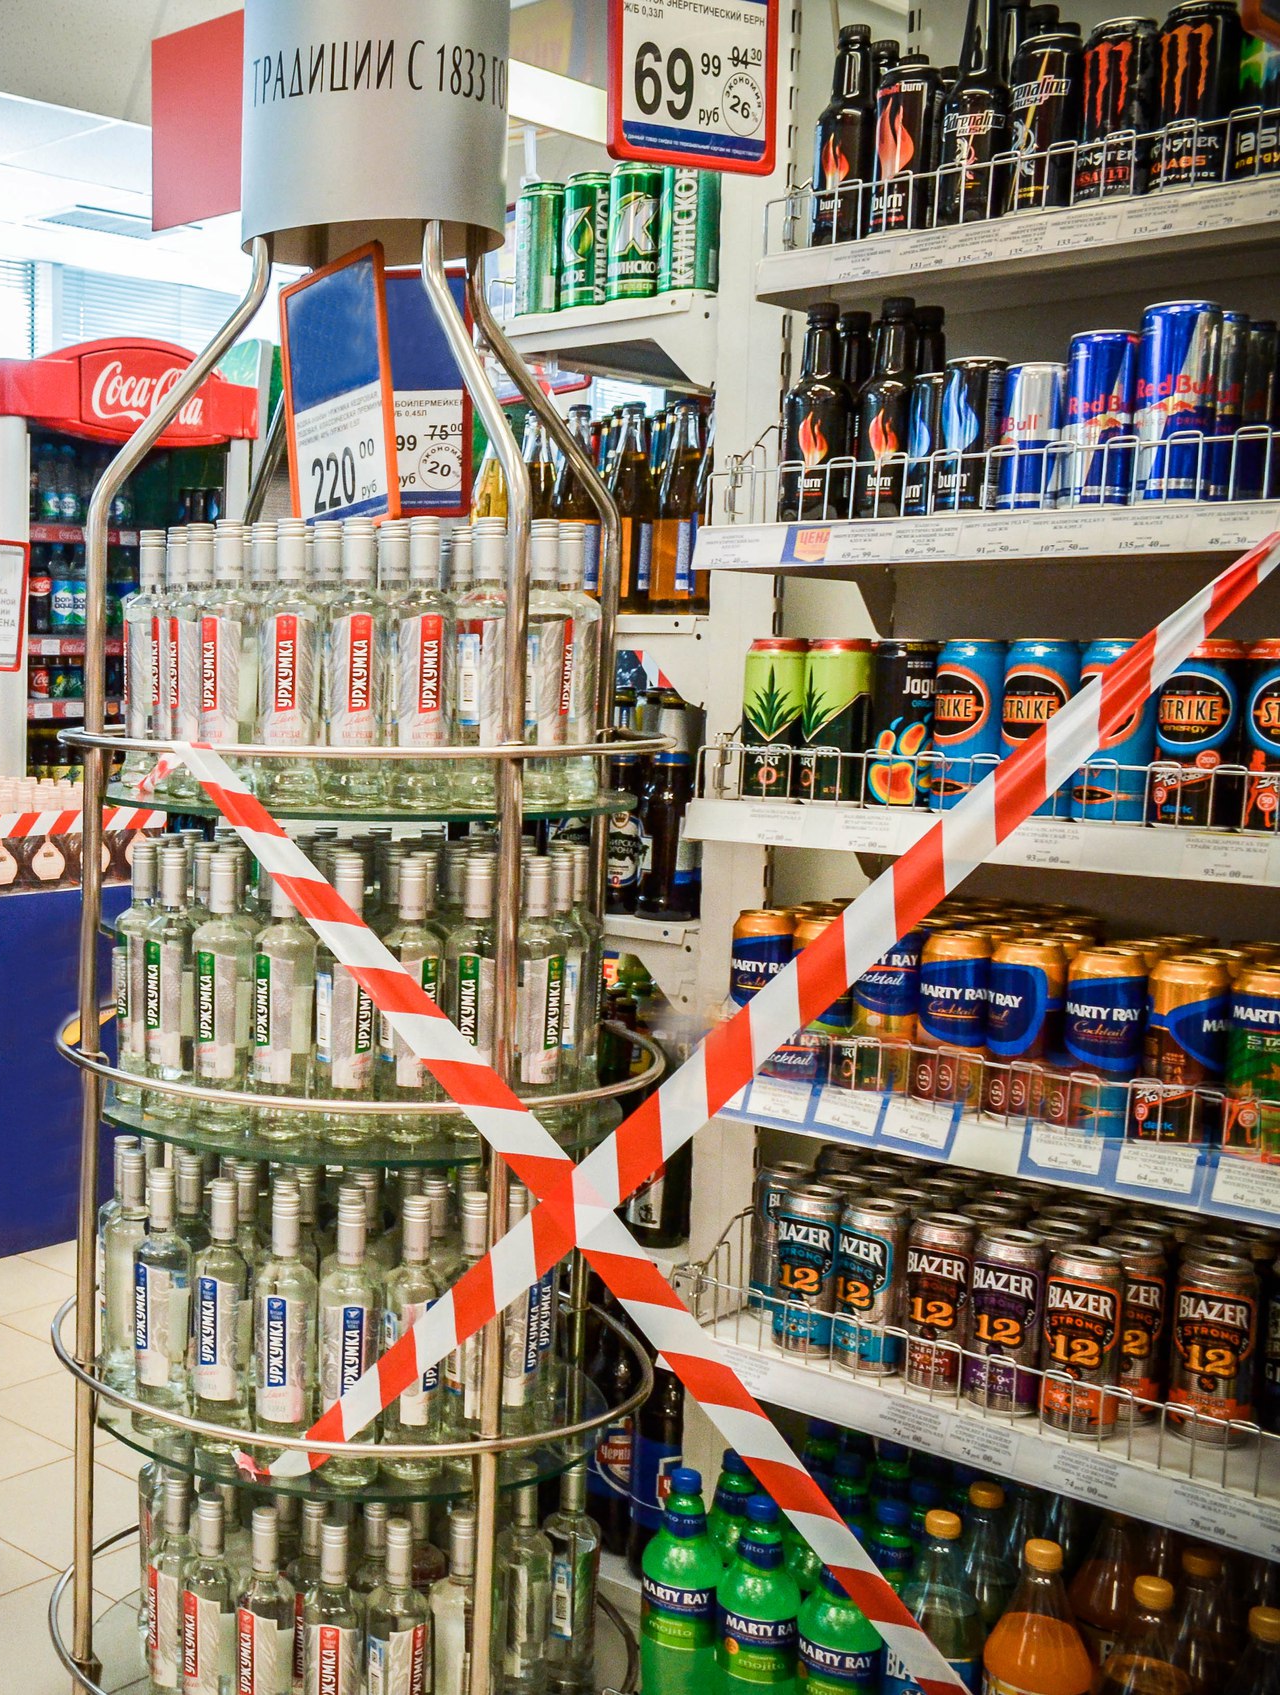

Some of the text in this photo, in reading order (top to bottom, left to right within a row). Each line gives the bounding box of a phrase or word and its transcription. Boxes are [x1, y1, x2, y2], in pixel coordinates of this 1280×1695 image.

[641, 8, 664, 19] 0,33Л
[667, 0, 766, 27] ЭНЕРГЕТИЧЕСКИЙ БЕРН
[731, 46, 762, 69] 94 30
[253, 40, 507, 111] ТРАДИЦИИ С 1833 ГО
[634, 41, 721, 121] 69 99
[725, 76, 762, 109] ЭКОНОМИЯ
[698, 107, 720, 126] руб
[1077, 149, 1138, 168] ONSTER
[820, 198, 843, 211] burn
[871, 193, 905, 211] burn
[671, 168, 698, 285] КЛИНСКОЕ
[1137, 375, 1172, 398] Red
[1070, 394, 1104, 415] Red
[396, 435, 417, 451] 99
[429, 425, 449, 440] 75
[311, 438, 375, 514] 220 00
[361, 479, 377, 500] руб
[798, 476, 823, 488] burn
[867, 474, 893, 487] burn
[937, 471, 970, 489] burn
[202, 641, 215, 708] УРЖУМКА
[277, 640, 294, 707] УРЖУМКА
[352, 640, 369, 708] УРЖУМКА
[422, 640, 438, 709] УРЖУМКА
[935, 697, 972, 718] TRIKE
[1003, 698, 1056, 719] STRIKE
[1160, 700, 1219, 722] STRIKE
[1163, 725, 1208, 734] energy
[891, 954, 918, 966] RAY
[147, 964, 158, 1026] УРЖУМКА
[920, 983, 962, 1000] MARTY
[995, 993, 1023, 1008] RAY
[200, 975, 212, 1039] УРЖУМКА
[256, 978, 268, 1043] УРЖУМКА
[546, 980, 561, 1045] УРЖУМКА
[1066, 1002, 1141, 1021] MARTY RAY
[779, 1220, 832, 1252] BLAZER
[840, 1233, 883, 1267] AZER
[780, 1264, 820, 1293] 12
[908, 1251, 966, 1283] BLAZER
[837, 1276, 871, 1307] 12
[973, 1267, 1034, 1300] BLAZER
[1126, 1284, 1160, 1309] ZER
[136, 1286, 146, 1347] УРЖУМКА
[538, 1285, 552, 1346] УРЖУМКА
[910, 1297, 954, 1327] 12
[1048, 1285, 1113, 1320] BLAZER
[1179, 1294, 1248, 1329] BLAZER
[201, 1301, 214, 1363] УРЖУМКА
[526, 1305, 539, 1368] УРЖУМКА
[975, 1314, 1021, 1345] 12
[1052, 1315, 1104, 1336] STRONG
[1184, 1326, 1240, 1345] STRONG
[269, 1321, 284, 1385] УРЖУМКА
[1051, 1335, 1100, 1368] 12
[1185, 1344, 1237, 1377] 12
[970, 1377, 1015, 1392] GRAVIOL
[643, 1577, 710, 1605] MARTY RAY
[649, 1617, 693, 1637] mojito
[726, 1614, 775, 1636] MARTY
[185, 1613, 196, 1674] УРЖУМКА
[799, 1639, 871, 1669] MARTY RAY
[240, 1632, 251, 1694] УРЖУМКА
[738, 1657, 785, 1671] mojito
